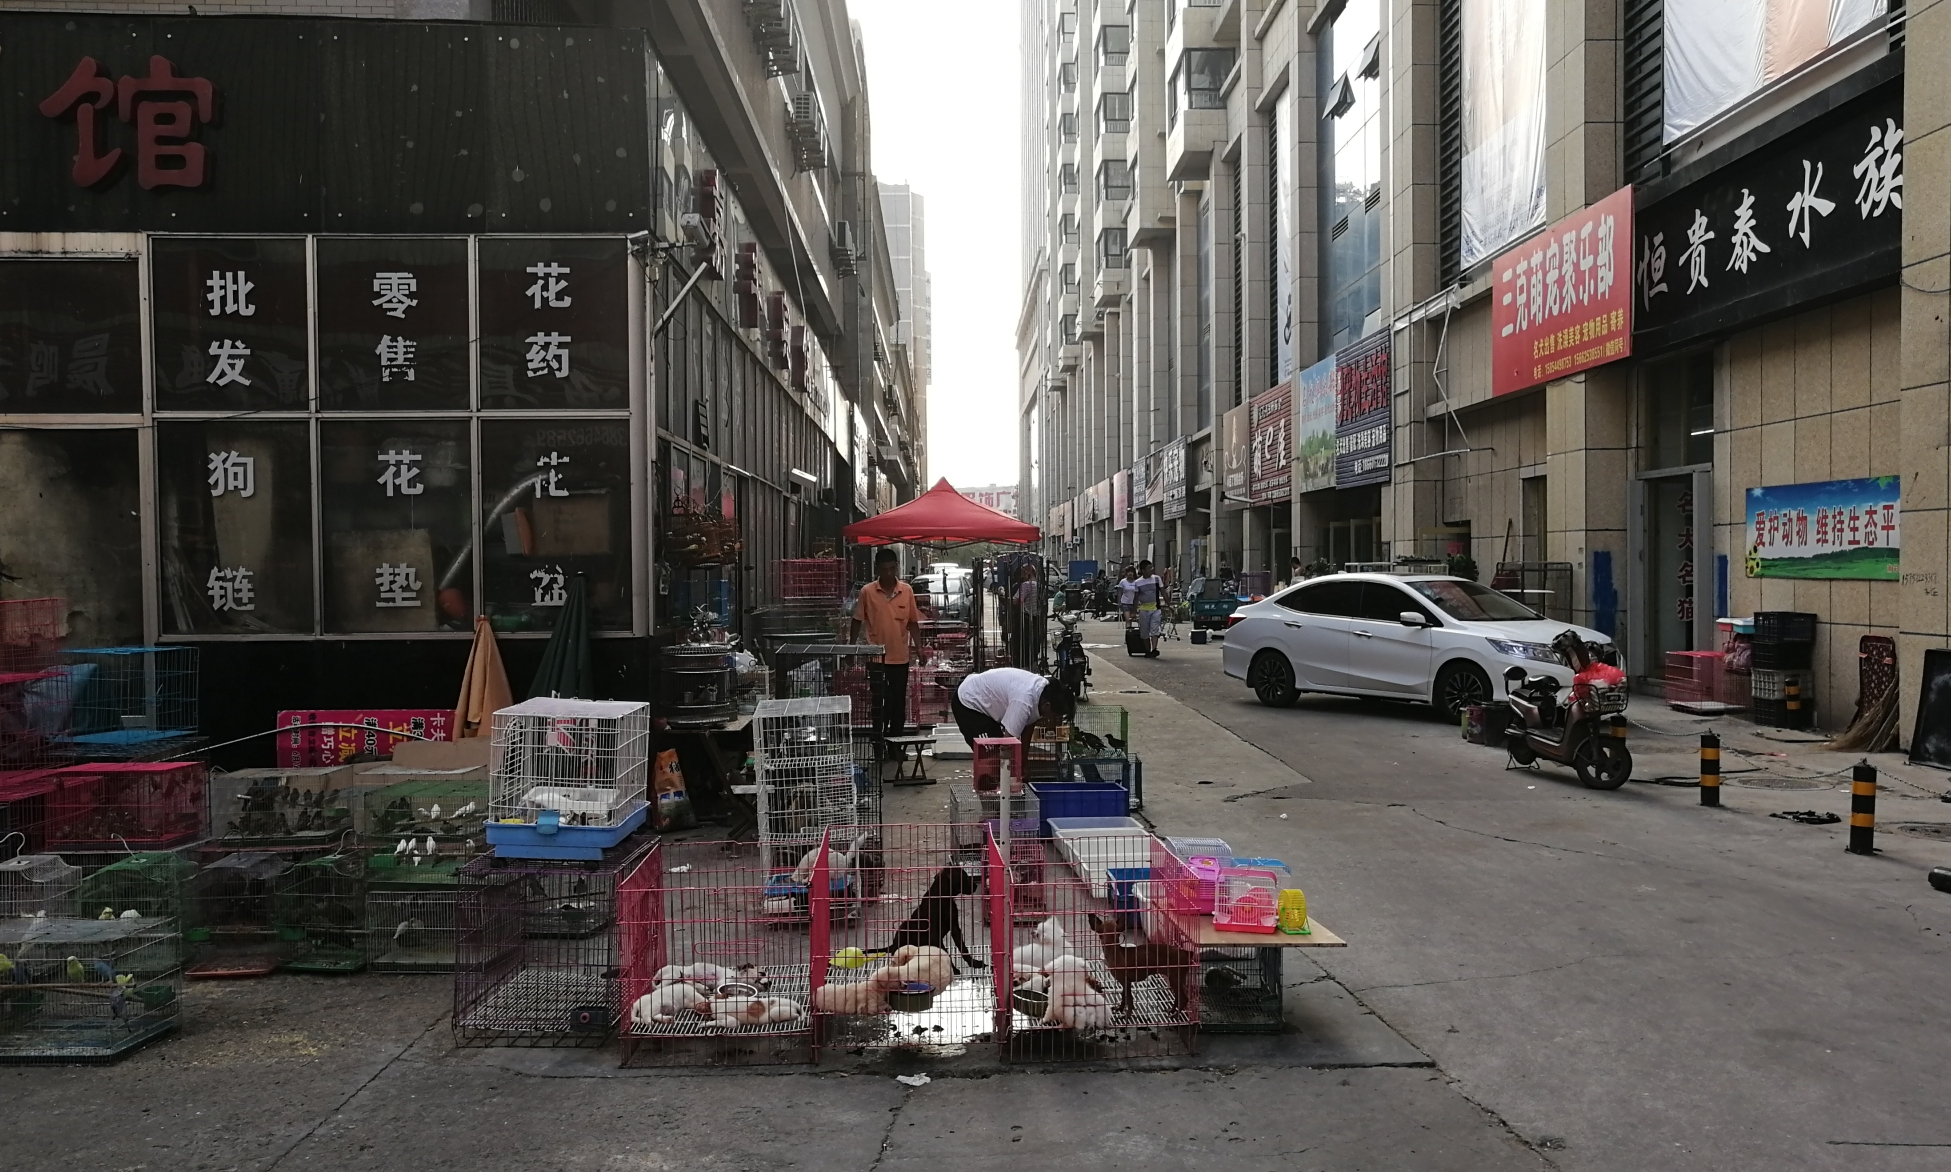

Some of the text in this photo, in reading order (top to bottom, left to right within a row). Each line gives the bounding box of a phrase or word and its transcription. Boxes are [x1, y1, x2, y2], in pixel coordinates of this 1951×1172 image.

[38, 54, 214, 191] 馆
[1502, 213, 1615, 338] 三克萌宠聚乐部
[1637, 118, 1904, 312] 恒贵泰水族
[206, 270, 256, 387] 批发
[525, 262, 572, 379] 花药
[206, 450, 256, 612] 狗链
[1754, 504, 1900, 548] 爱护动物 维持生态平
